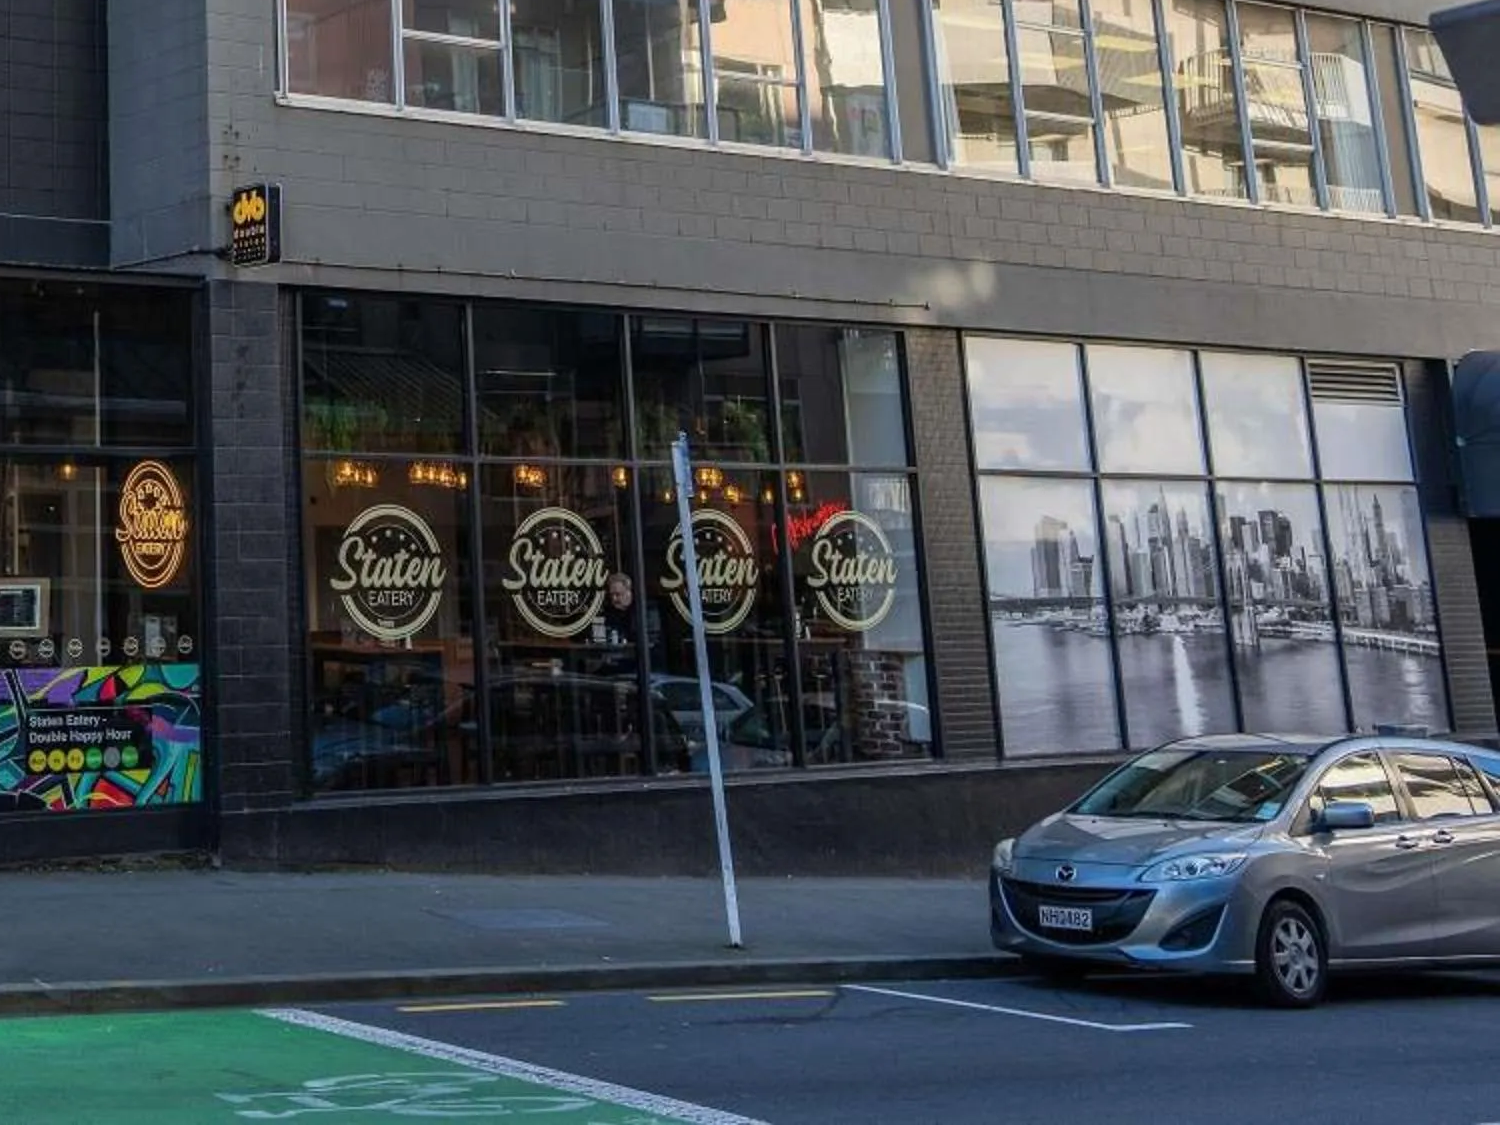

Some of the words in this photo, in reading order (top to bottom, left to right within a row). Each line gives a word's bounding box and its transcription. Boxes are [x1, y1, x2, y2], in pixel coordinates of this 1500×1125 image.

[330, 535, 448, 591] Staten
[502, 537, 609, 591] Staten
[660, 538, 759, 591] Saten
[807, 538, 898, 588] Staten
[368, 590, 415, 606] EATERY
[537, 590, 581, 606] EATERY
[836, 587, 875, 603] EATERY
[29, 715, 63, 727] Staten
[66, 715, 101, 727] Eatery
[29, 731, 67, 744] Double
[69, 730, 104, 744] Happy
[105, 728, 132, 740] Hour
